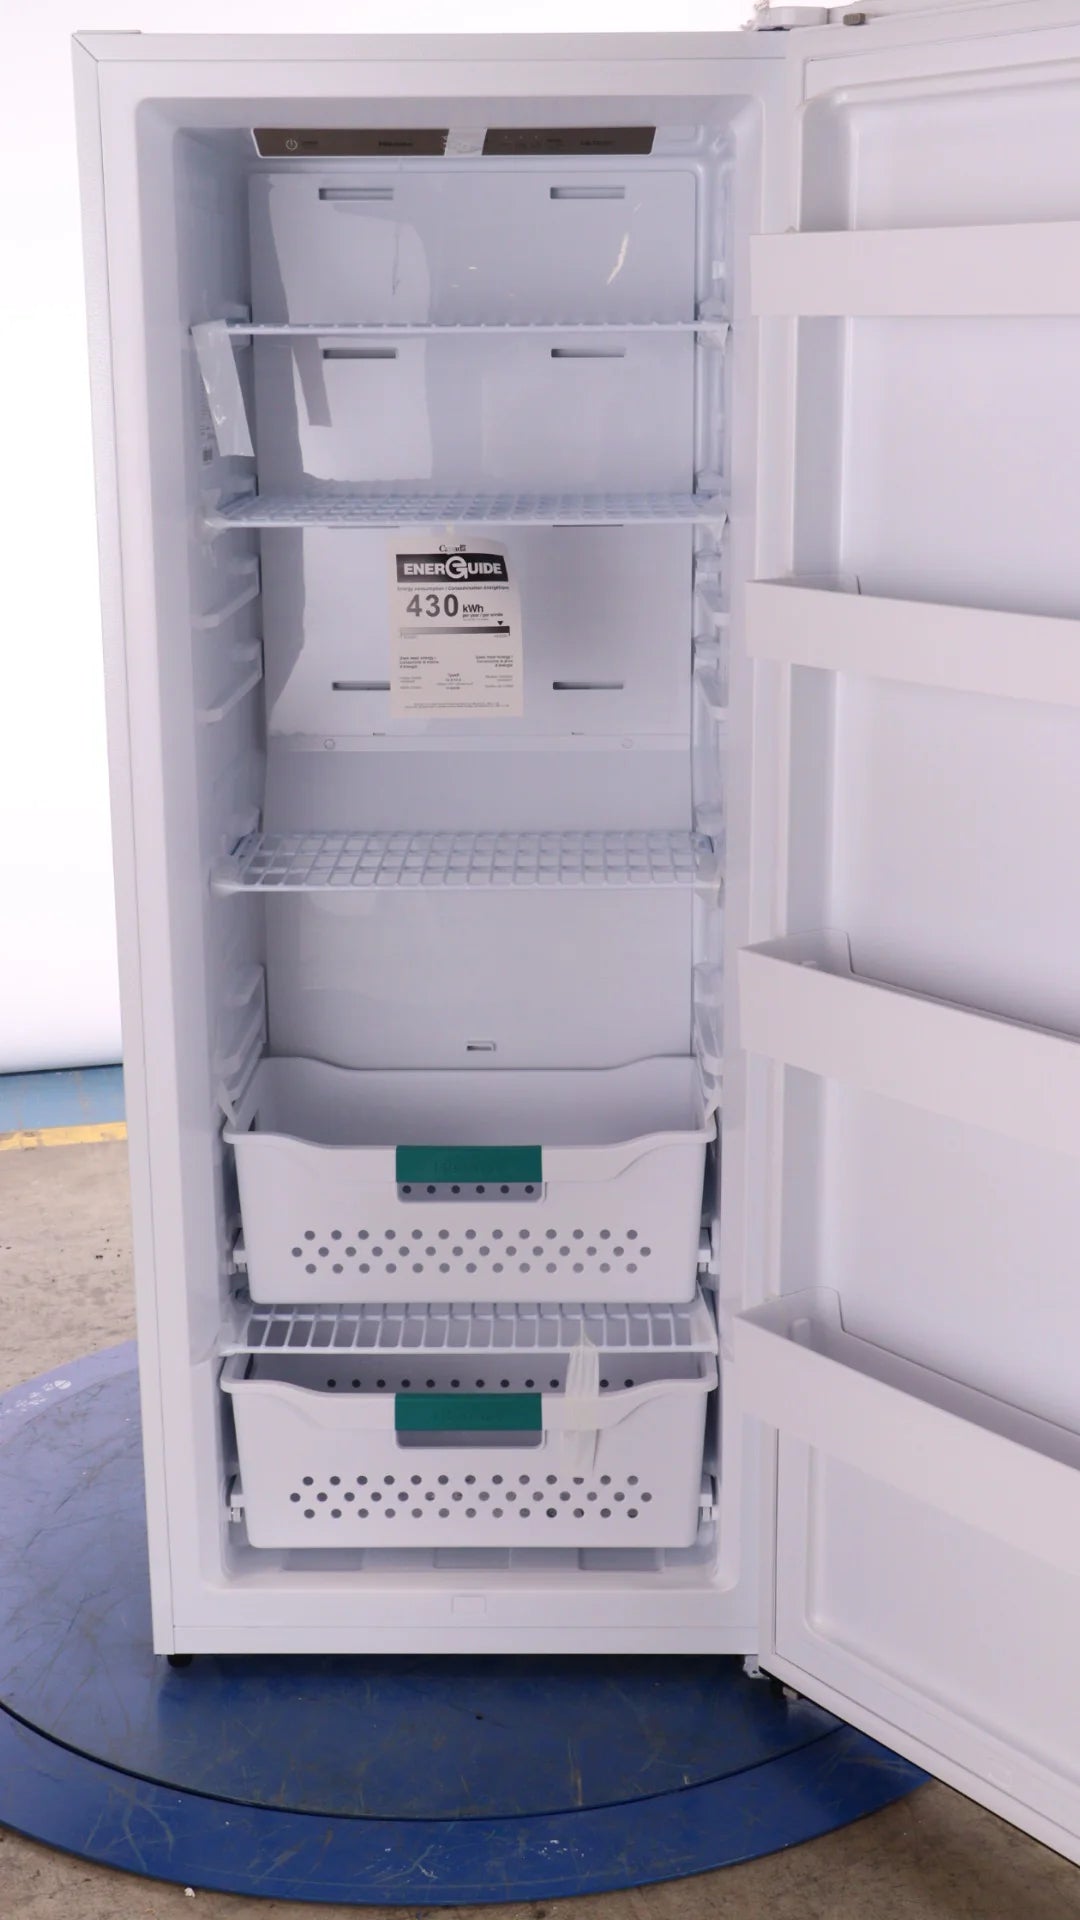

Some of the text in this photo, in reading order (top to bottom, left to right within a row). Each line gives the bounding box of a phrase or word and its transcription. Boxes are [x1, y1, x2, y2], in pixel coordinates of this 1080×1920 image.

[403, 555, 503, 580] ENERGUIDE
[406, 593, 484, 618] 430 kWh
